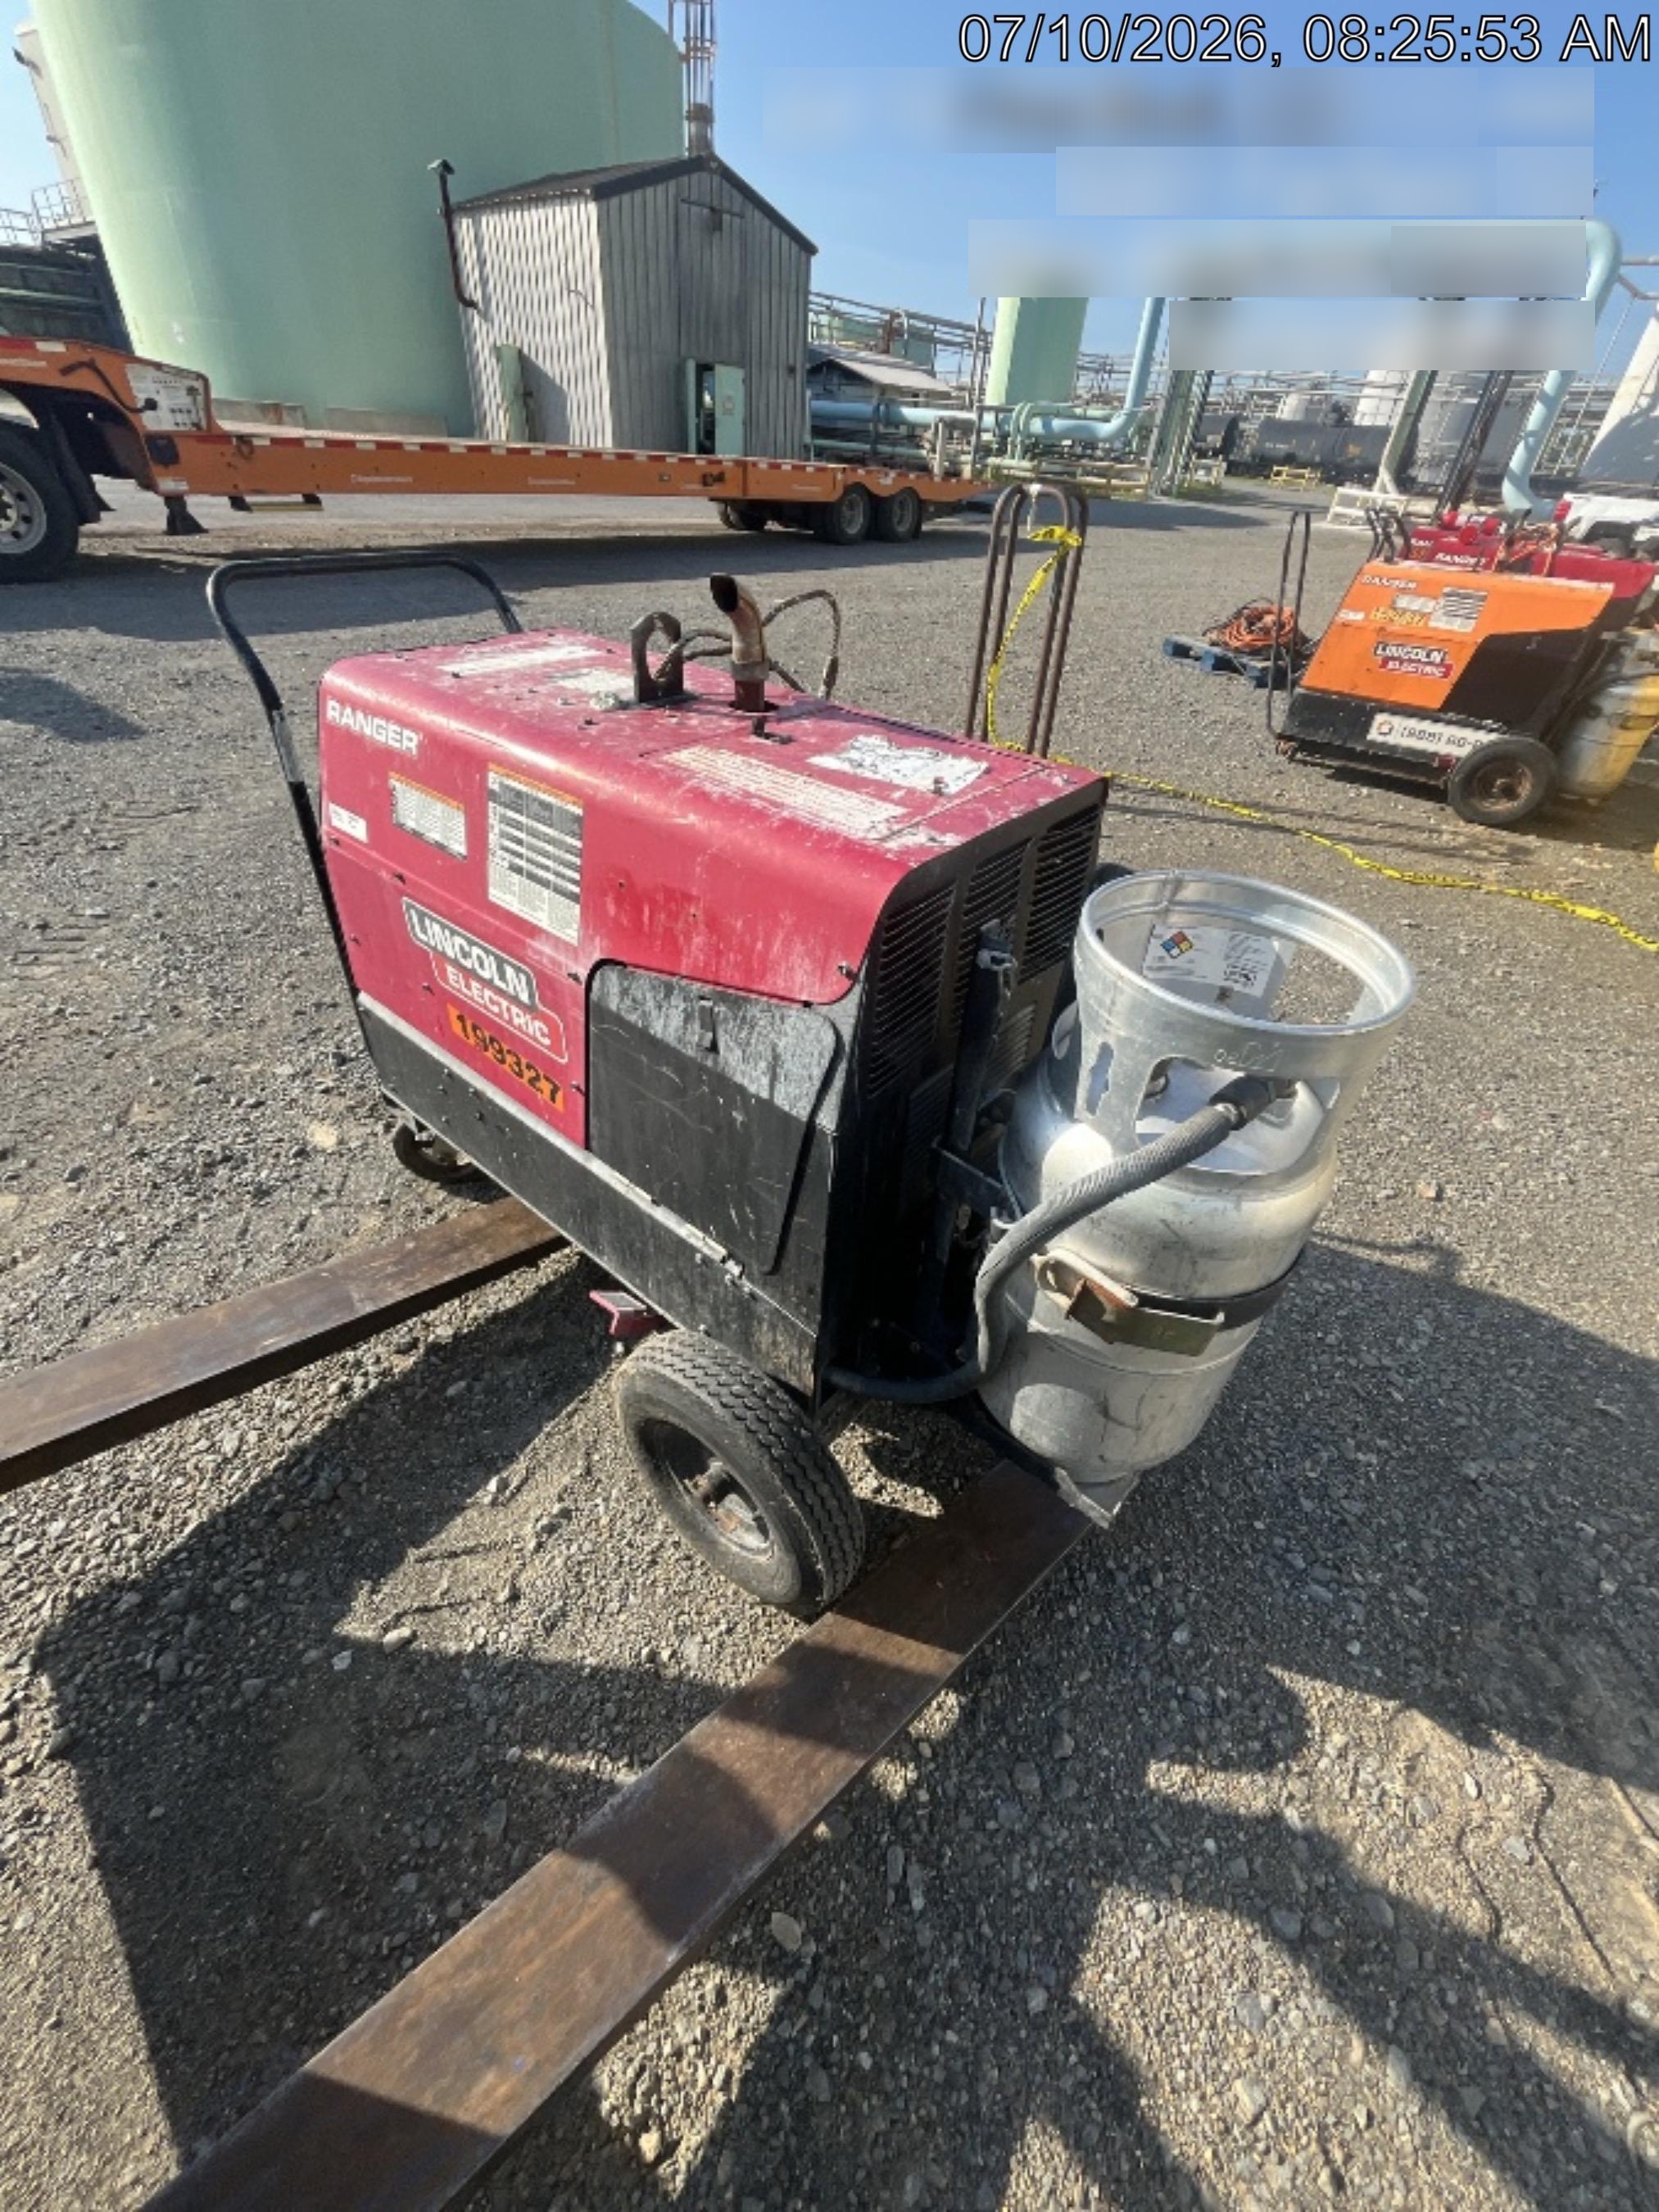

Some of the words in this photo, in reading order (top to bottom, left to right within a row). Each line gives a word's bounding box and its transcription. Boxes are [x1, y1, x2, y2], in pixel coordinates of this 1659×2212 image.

[326, 698, 419, 757] RANGER
[410, 907, 531, 1006] LINCOLN
[444, 961, 551, 1046] ELECTRIC
[456, 1013, 562, 1104] 199327
